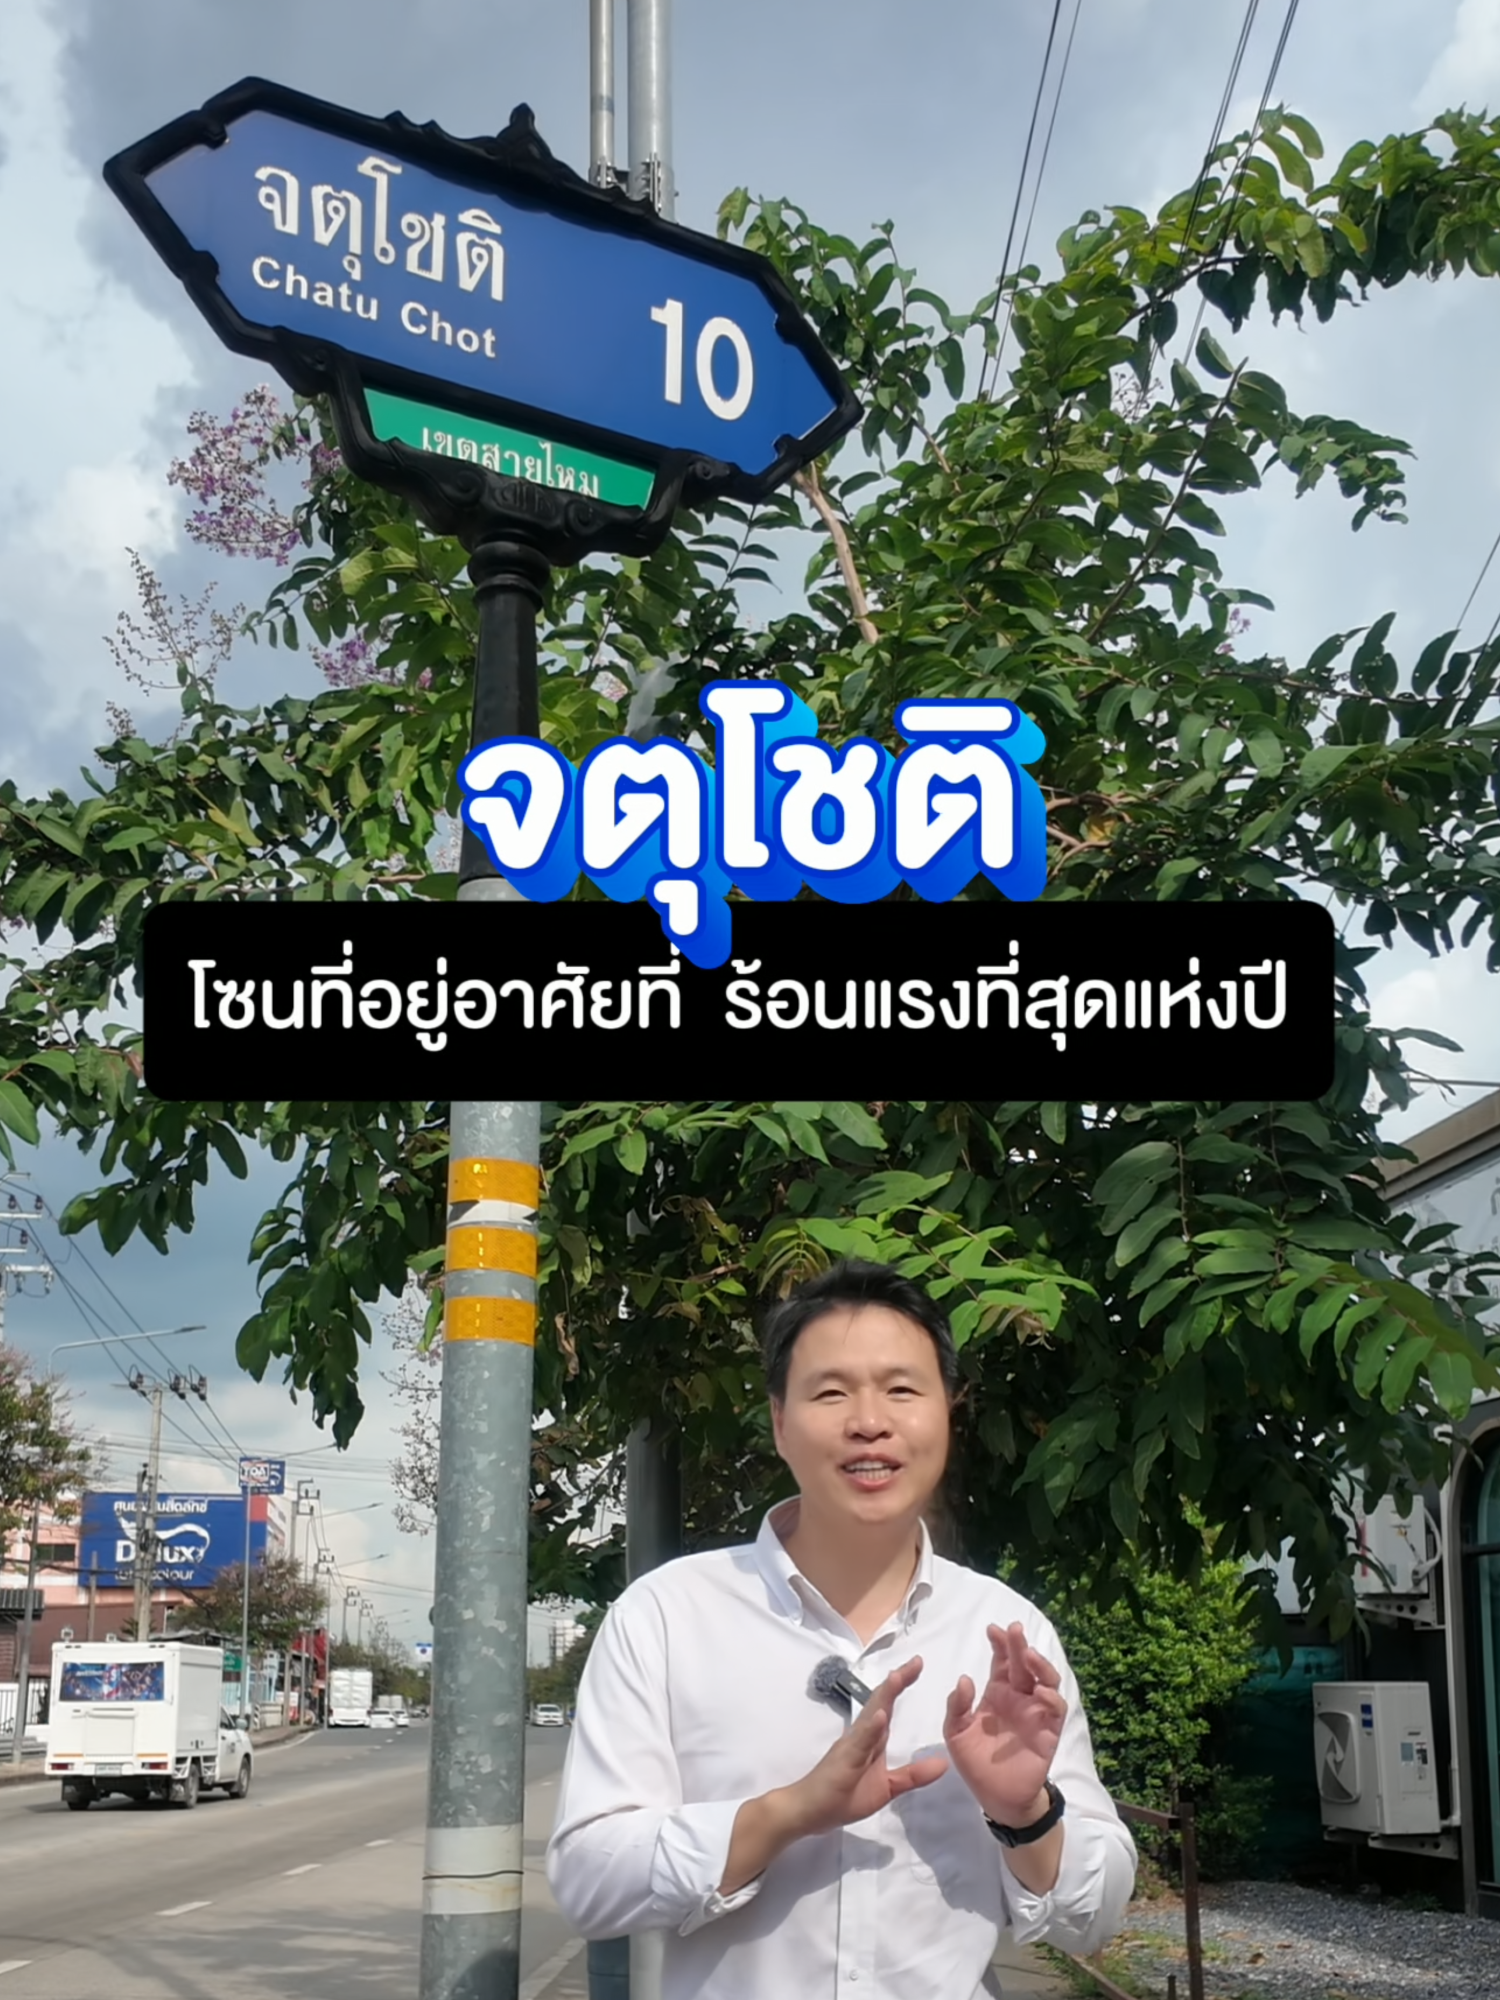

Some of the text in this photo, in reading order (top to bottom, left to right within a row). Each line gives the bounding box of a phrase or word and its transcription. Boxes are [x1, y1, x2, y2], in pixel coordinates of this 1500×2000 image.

[254, 155, 505, 303] จตุโชติ
[252, 255, 496, 358] Chatu Chot
[650, 298, 754, 421] 10
[116, 1540, 201, 1563] Dlux
